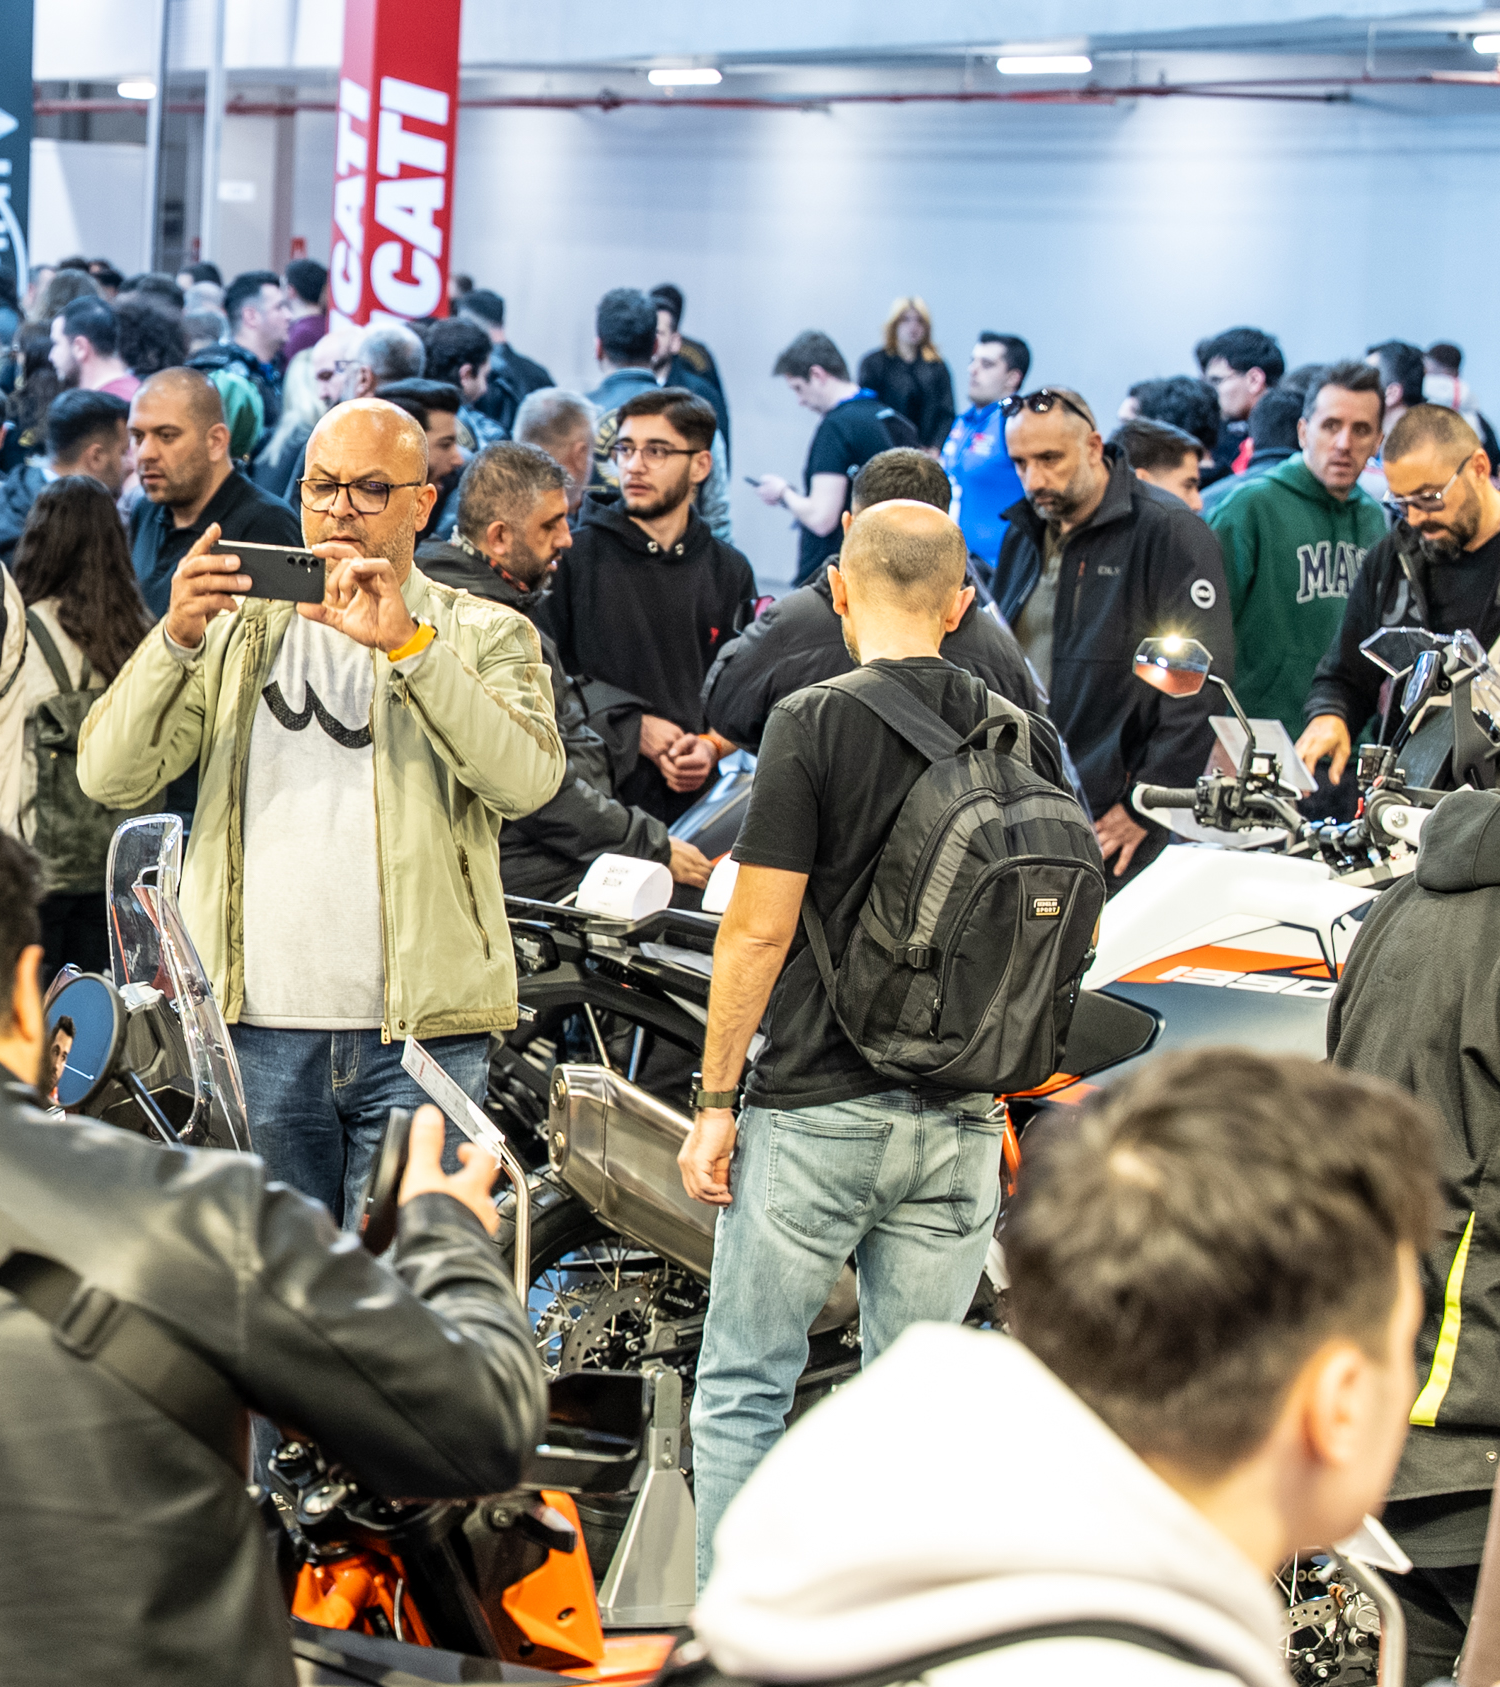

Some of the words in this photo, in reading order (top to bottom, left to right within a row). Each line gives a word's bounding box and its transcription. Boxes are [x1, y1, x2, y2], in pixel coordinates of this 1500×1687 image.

[329, 77, 370, 332] CATI
[370, 75, 450, 324] CATI
[1155, 965, 1339, 1000] 1390
